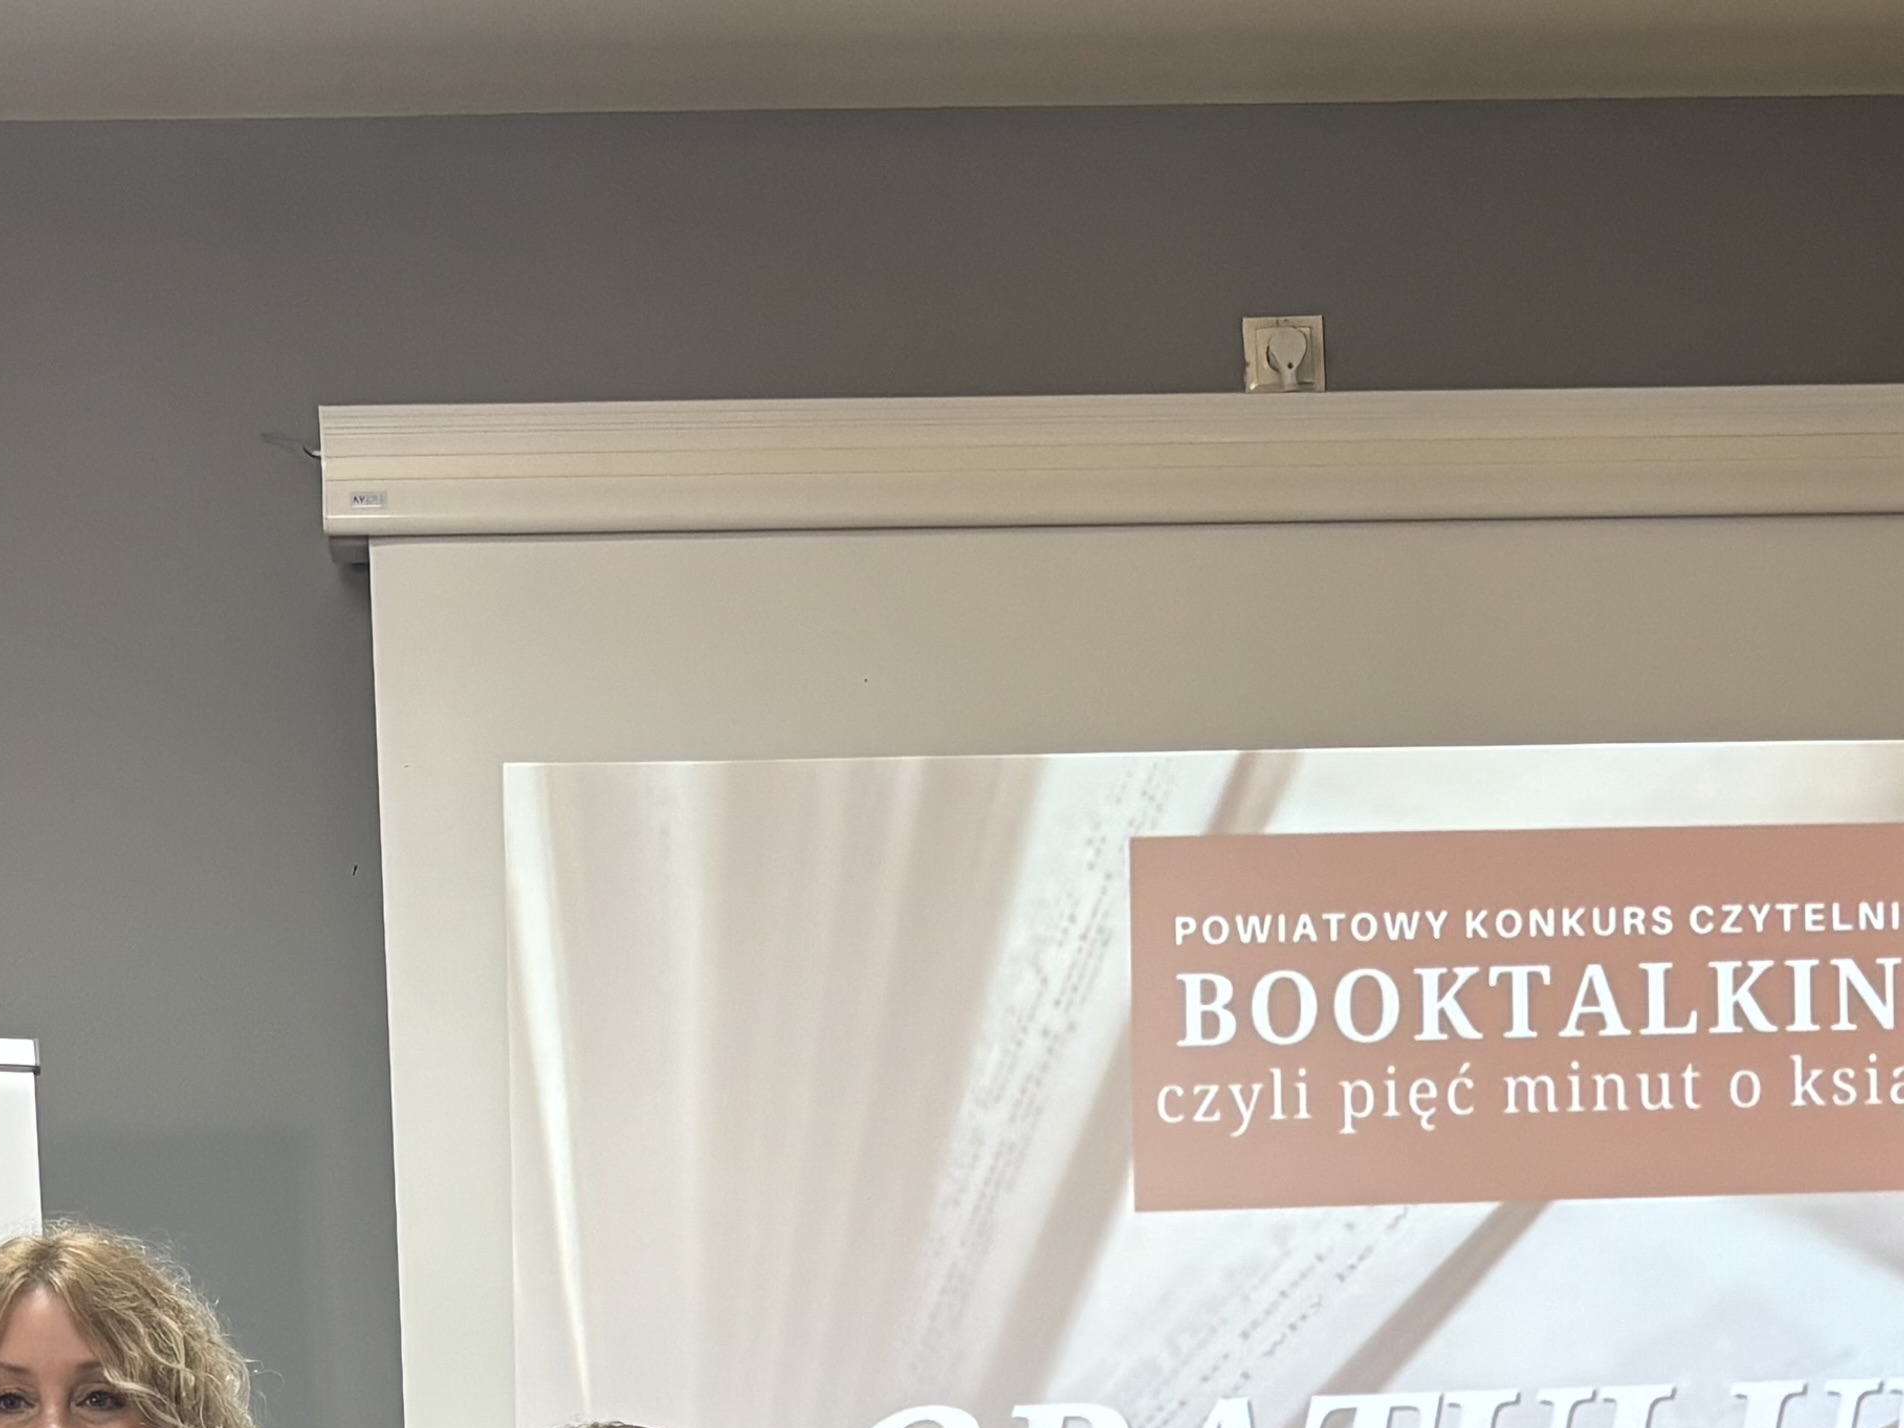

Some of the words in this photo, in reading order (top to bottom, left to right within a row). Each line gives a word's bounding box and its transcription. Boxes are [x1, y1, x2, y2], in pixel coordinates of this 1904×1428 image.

[1176, 911, 1447, 945] POWIATOWY
[1466, 906, 1673, 938] KONKURS
[1158, 1068, 1310, 1136] czyli
[1340, 1062, 1473, 1134] pięć
[1504, 1061, 1700, 1113] minut
[1730, 1070, 1760, 1108] o
